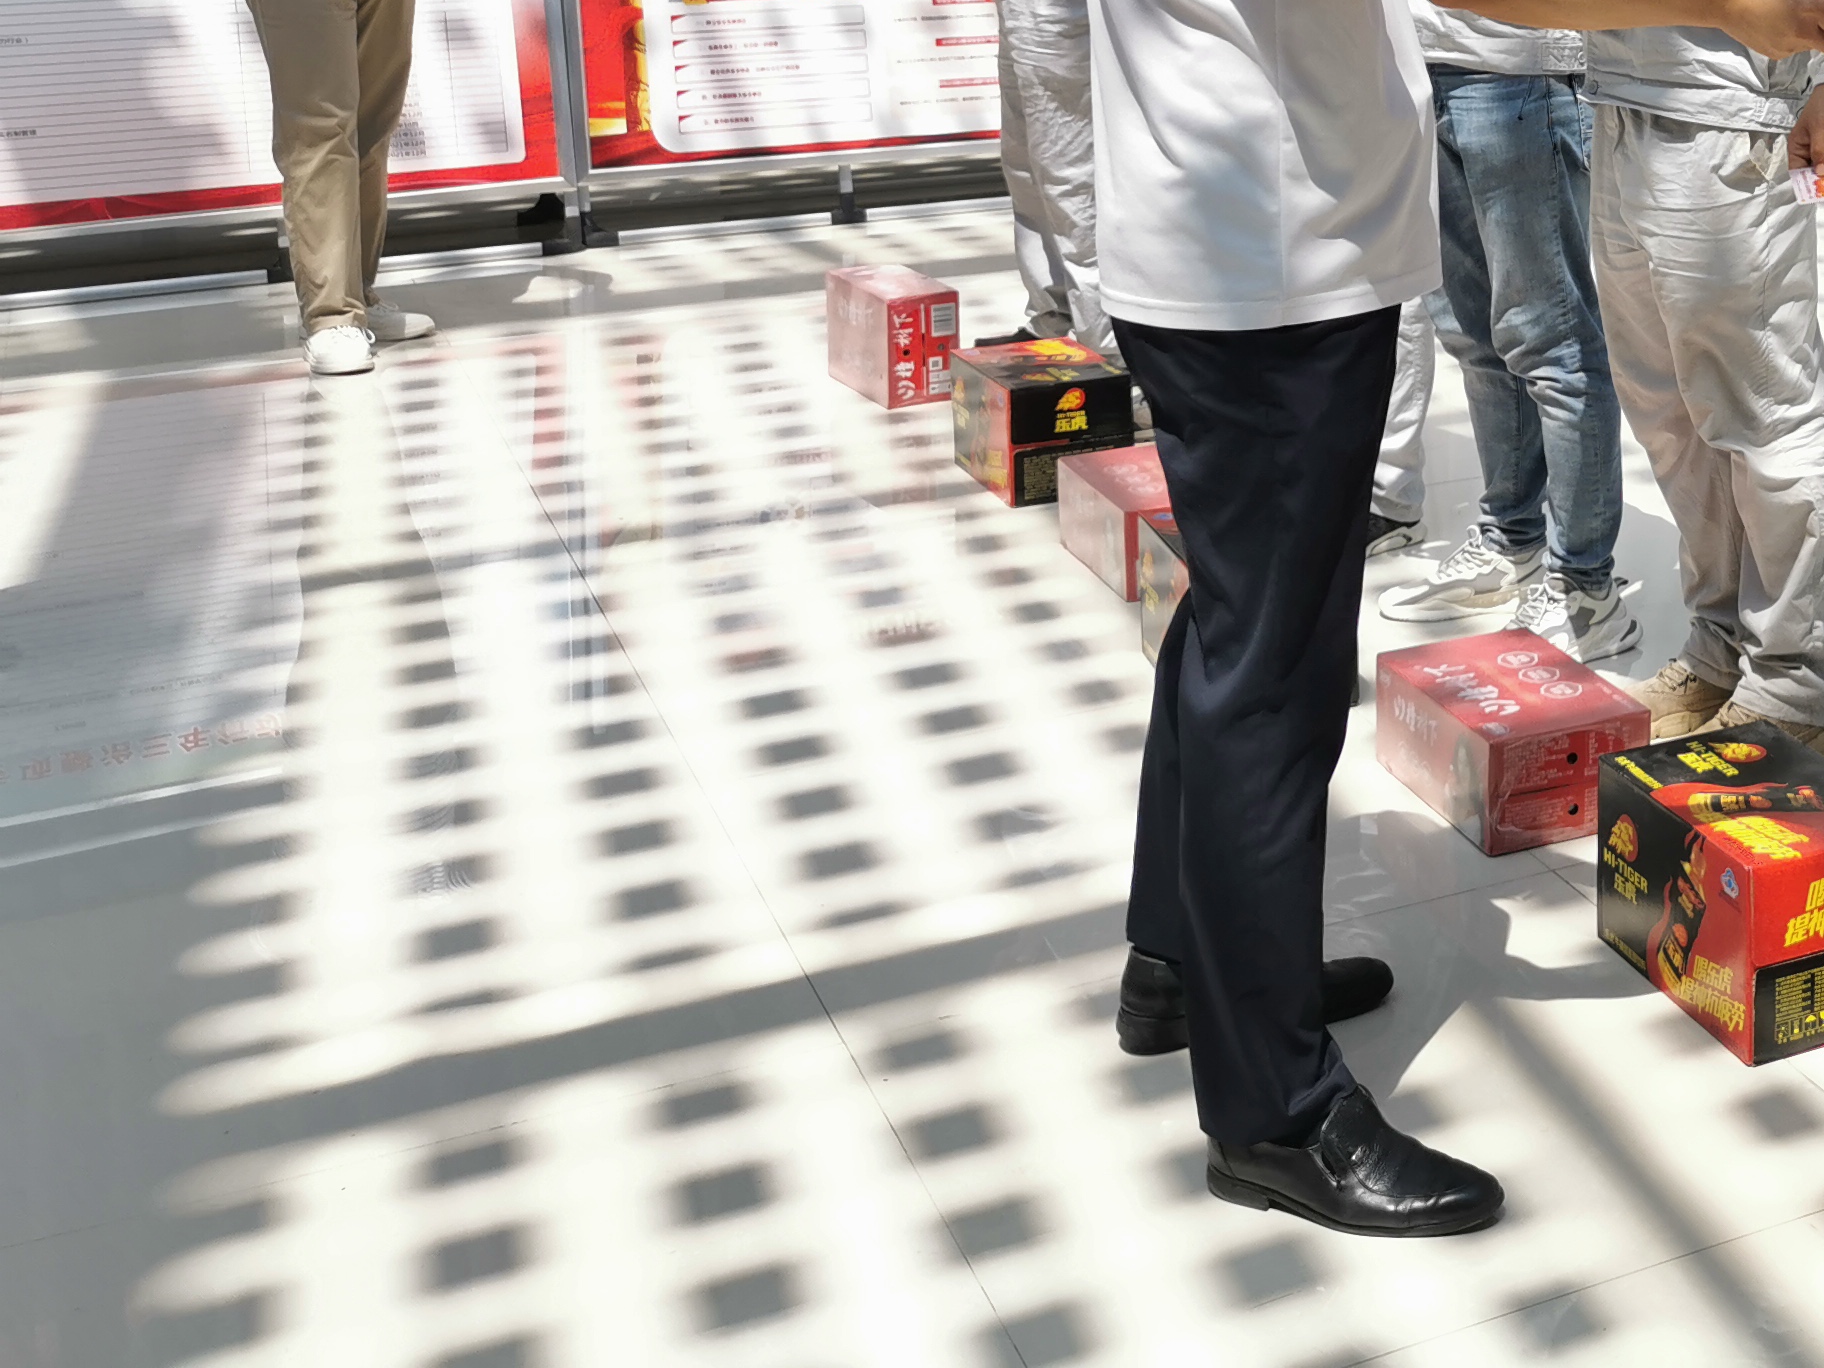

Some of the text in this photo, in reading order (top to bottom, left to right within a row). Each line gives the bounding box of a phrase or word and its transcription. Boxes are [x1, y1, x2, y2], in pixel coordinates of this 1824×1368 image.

[1054, 416, 1088, 434] 乐虎
[1686, 741, 1739, 777] HI-TIGER
[1603, 846, 1648, 894] HI-TIGER
[1613, 872, 1638, 905] 乐虎
[1693, 955, 1734, 994] 喝乐虎
[1678, 975, 1746, 1031] 提神抗疲劳
